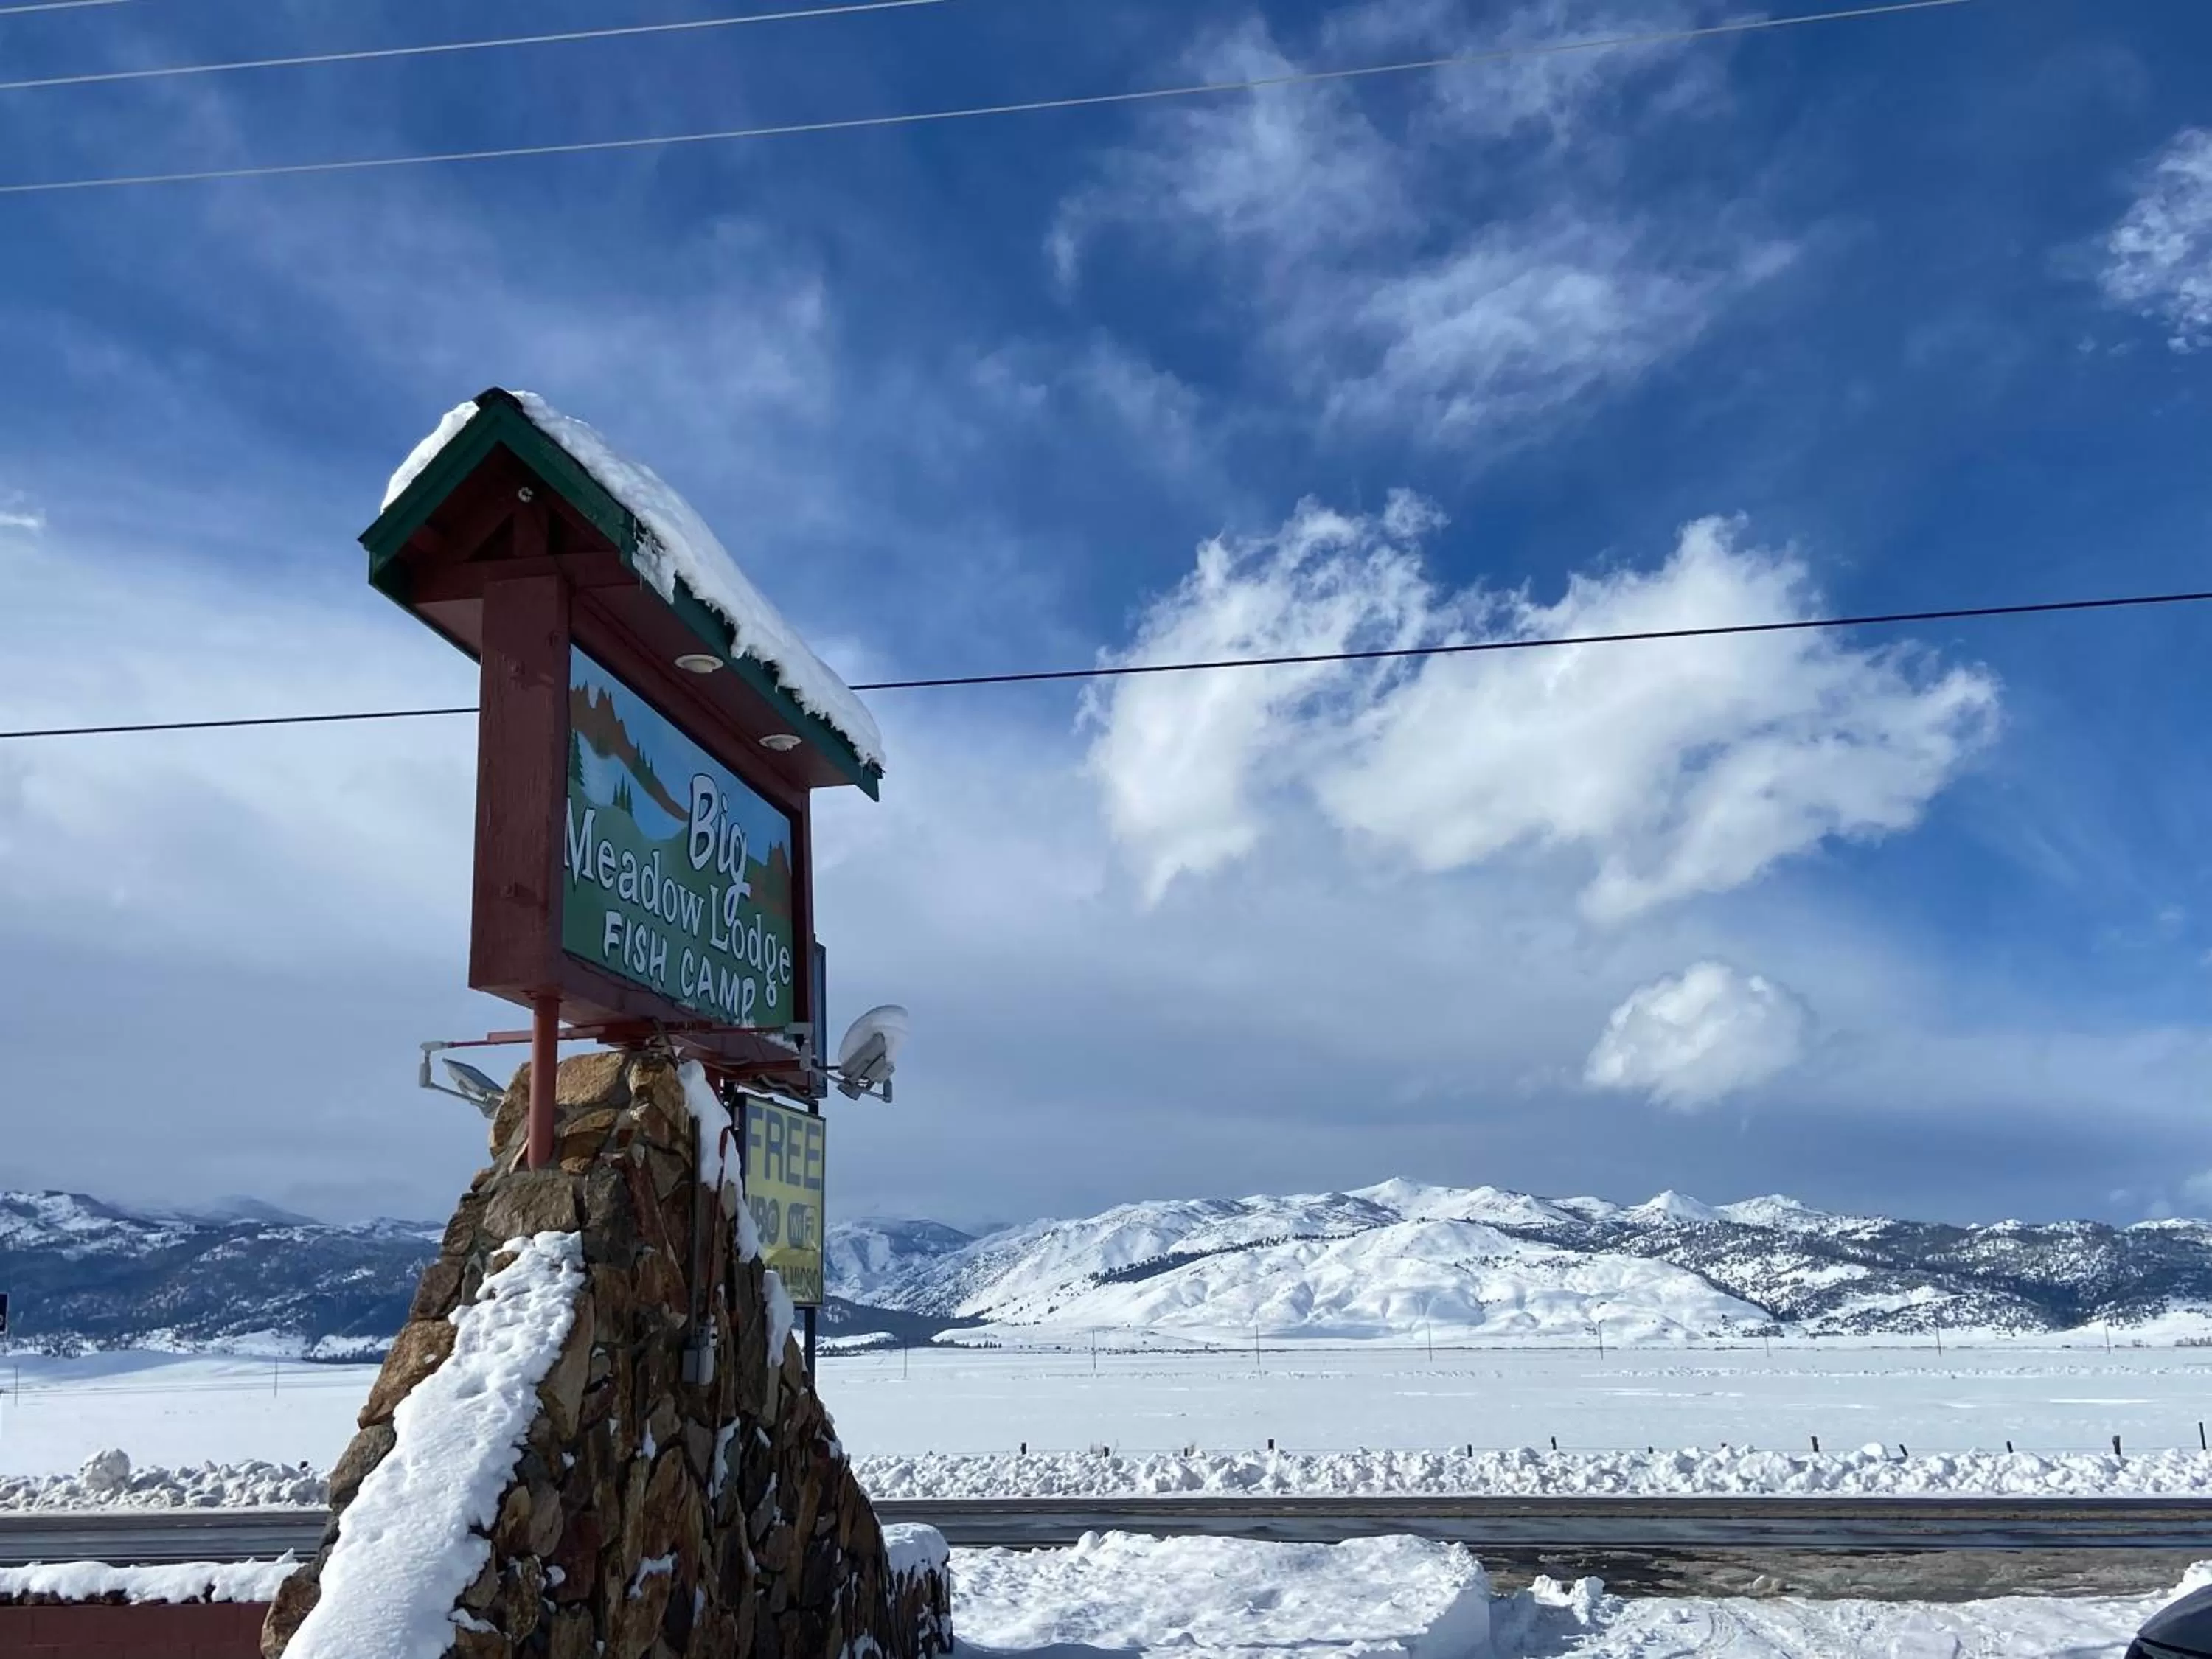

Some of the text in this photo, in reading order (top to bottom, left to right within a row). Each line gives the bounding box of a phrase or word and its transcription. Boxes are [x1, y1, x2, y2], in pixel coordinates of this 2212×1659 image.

[563, 797, 792, 1008] Meadow Lodge
[689, 773, 751, 928] Big
[602, 910, 757, 1026] FISH CAMP
[746, 1105, 821, 1191] FREE
